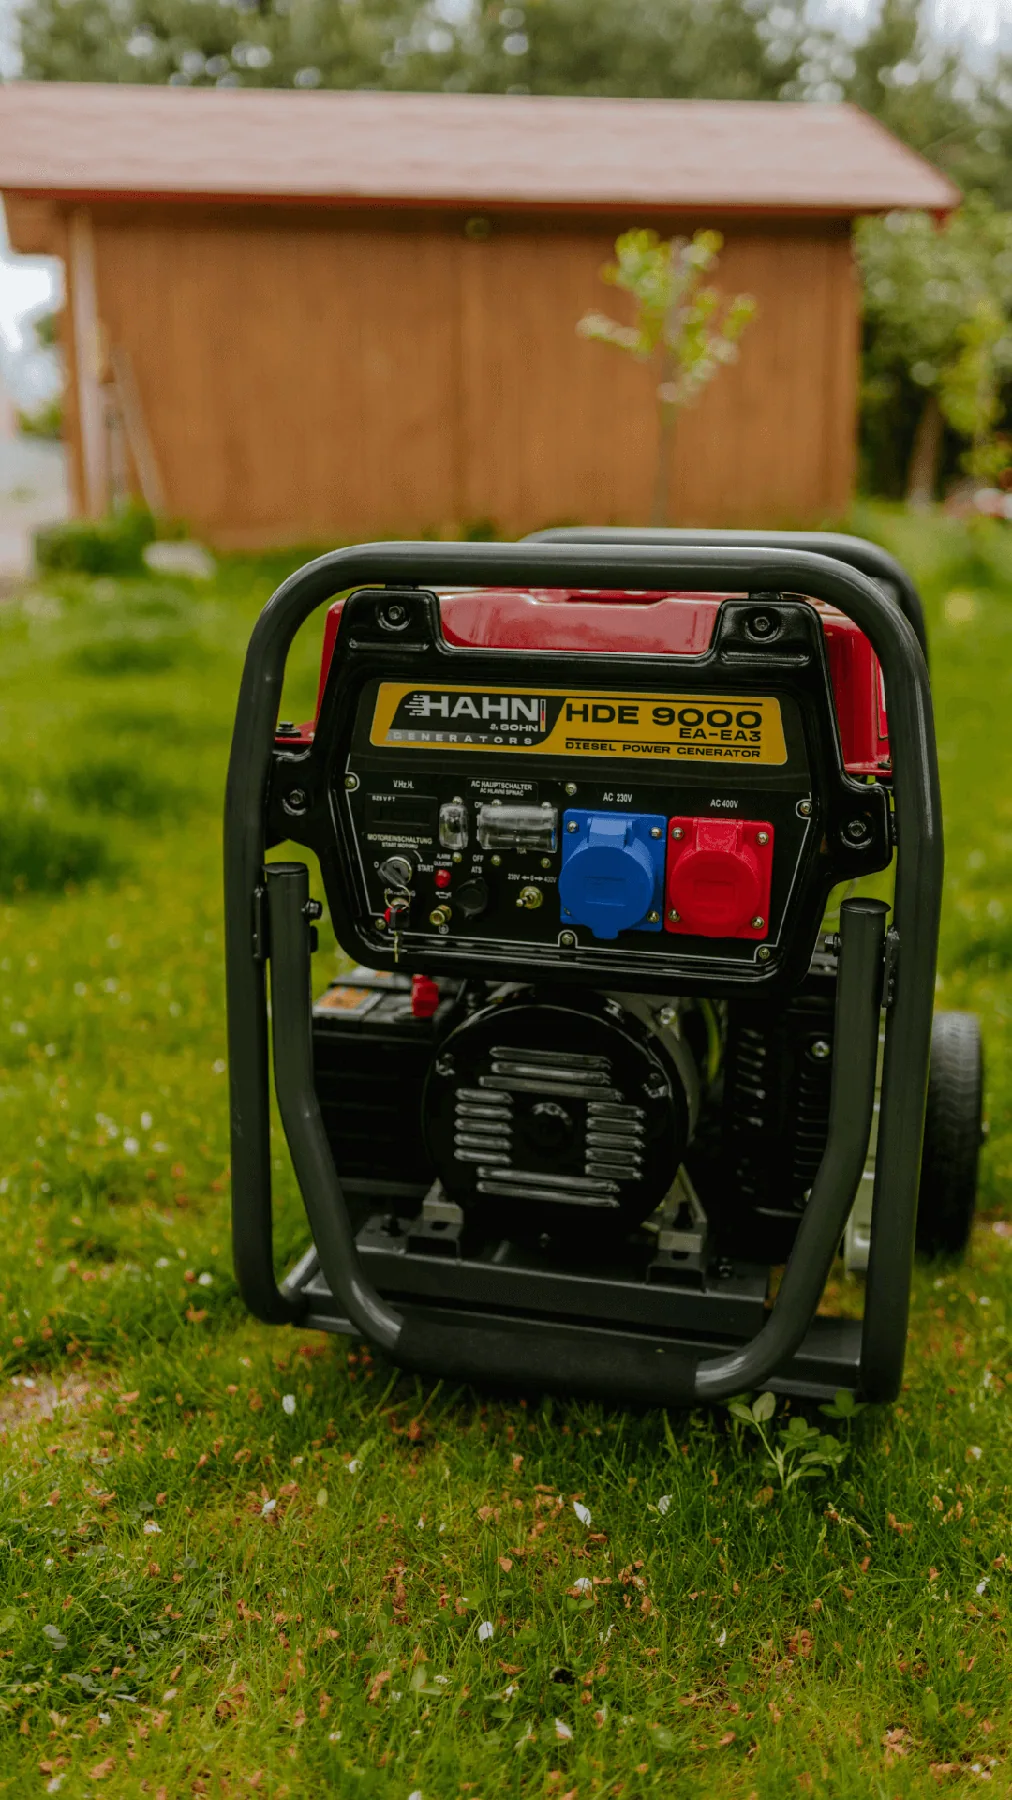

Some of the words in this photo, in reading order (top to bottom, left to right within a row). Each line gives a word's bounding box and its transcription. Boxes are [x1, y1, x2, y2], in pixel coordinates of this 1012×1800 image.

[414, 695, 539, 721] HAHN
[566, 703, 640, 725] HDE
[652, 707, 762, 729] 9000
[500, 724, 538, 732] SOHN
[392, 731, 533, 745] GENERATORS
[679, 728, 761, 742] EA-EA3
[565, 741, 616, 752] DIESEL
[622, 744, 671, 754] POWER
[677, 747, 761, 758] GENERATOR
[481, 781, 533, 791] HAUPTSCHALTER
[602, 792, 613, 802] AC
[616, 793, 633, 802] 230V
[710, 799, 721, 808] AC
[721, 800, 738, 809] 400V
[472, 854, 484, 862] OFF
[417, 864, 434, 872] START
[471, 866, 483, 874] ATS
